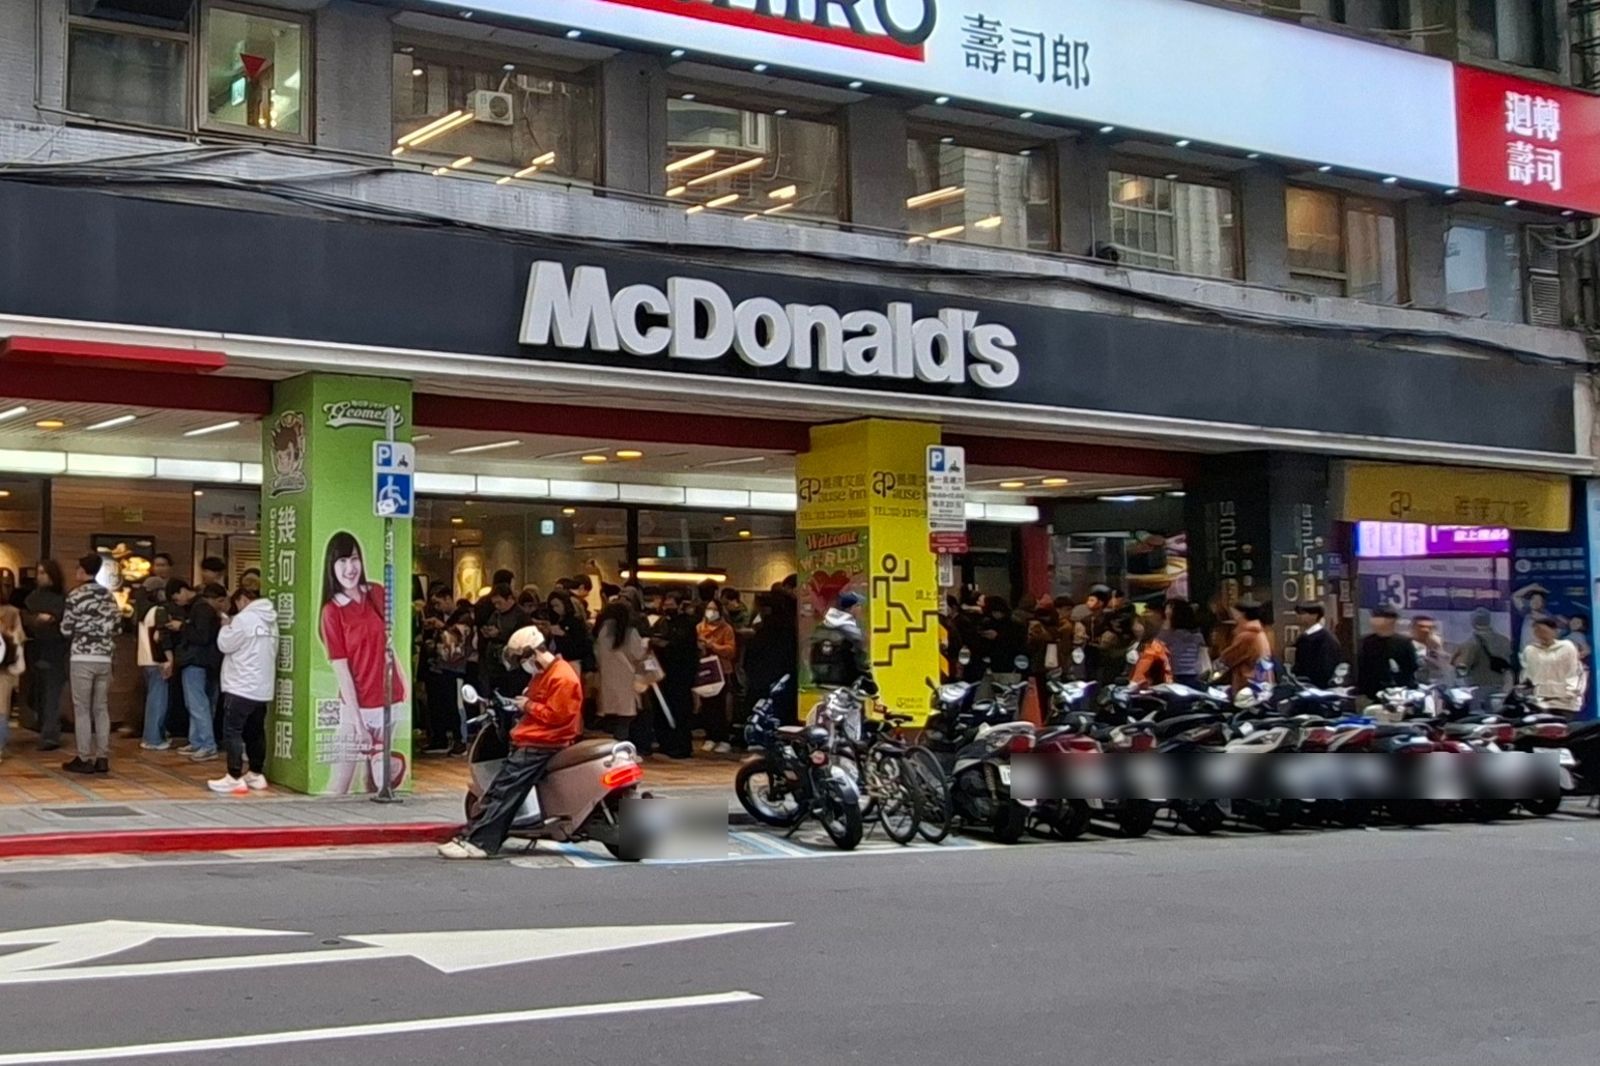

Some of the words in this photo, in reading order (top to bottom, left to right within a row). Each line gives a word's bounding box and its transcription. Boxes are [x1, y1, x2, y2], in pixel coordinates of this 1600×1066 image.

[961, 13, 1090, 90] 壽司郎
[1506, 140, 1562, 191] 壽司
[519, 260, 1020, 388] McDonald's
[323, 401, 405, 428] Geomety
[377, 445, 392, 466] P
[930, 450, 943, 470] P
